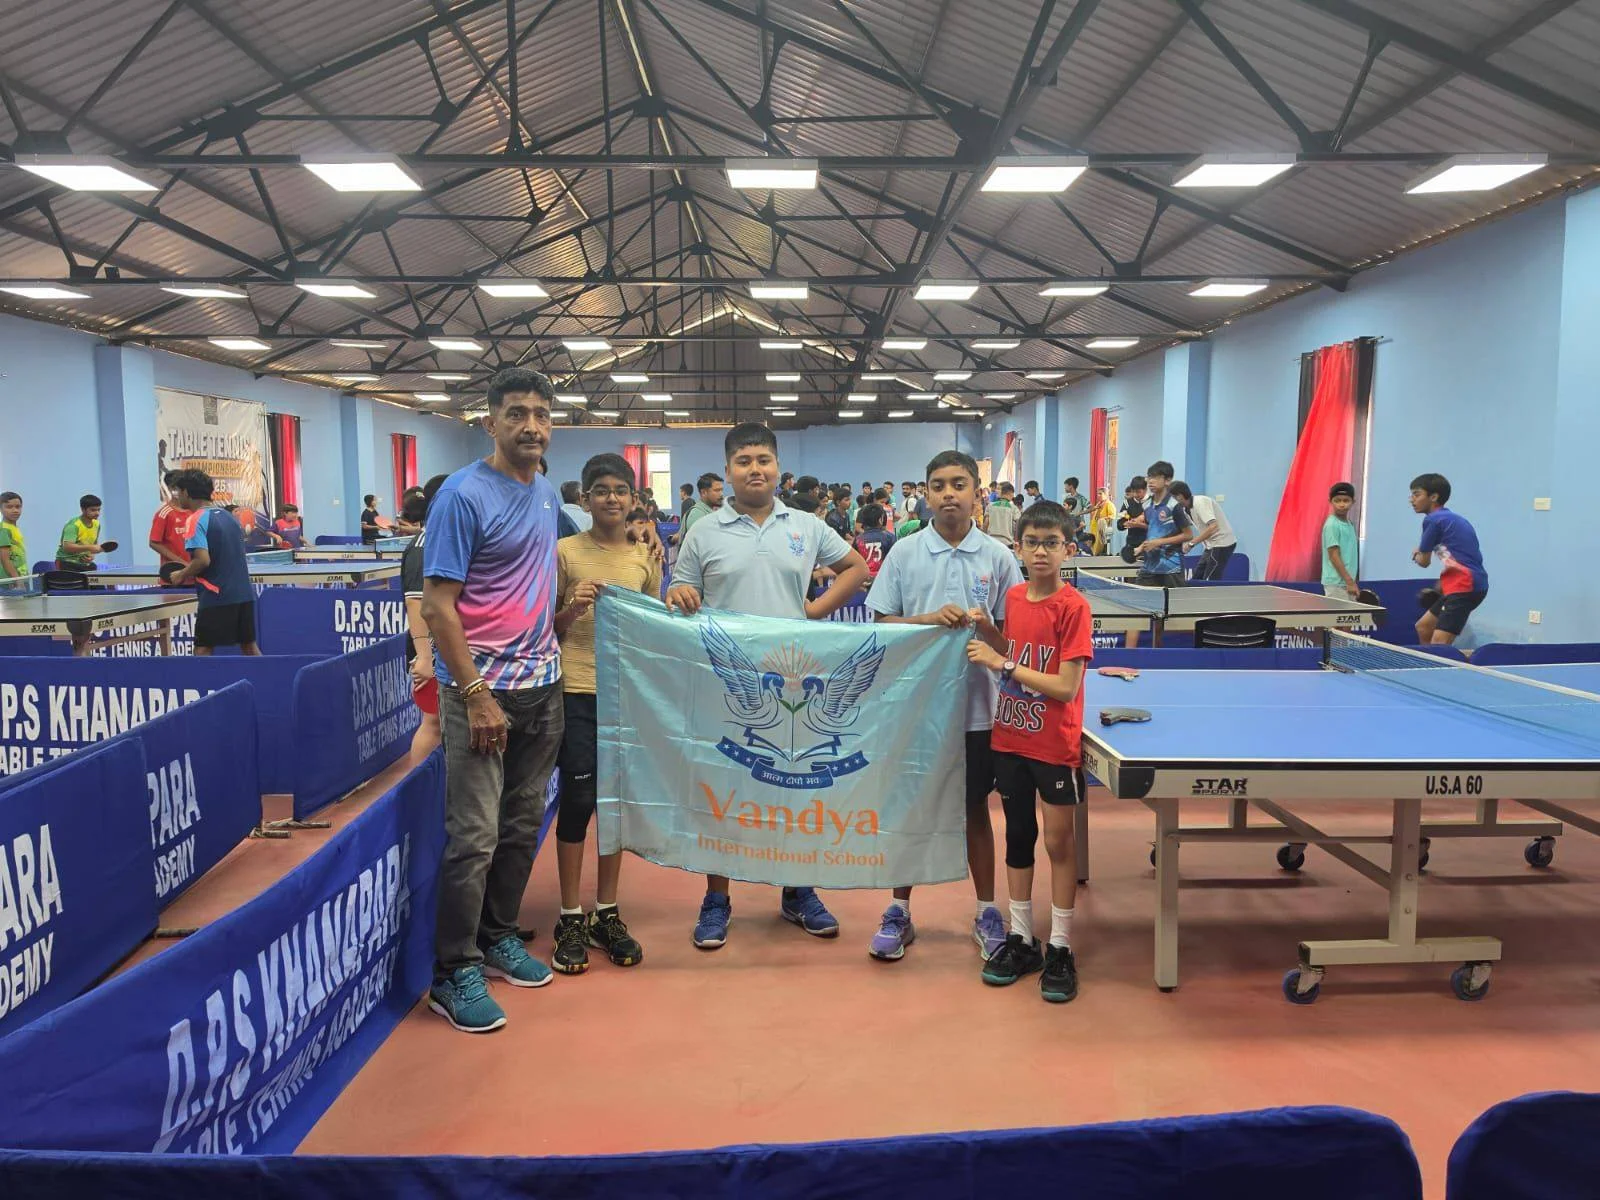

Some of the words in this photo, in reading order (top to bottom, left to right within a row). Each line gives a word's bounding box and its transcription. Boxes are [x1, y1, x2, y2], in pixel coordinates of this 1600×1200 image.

[168, 429, 208, 460] TABLE
[865, 541, 882, 562] 73
[334, 599, 375, 634] D.P.S
[111, 640, 151, 658] TENNIS
[1274, 634, 1314, 649] TENNIS
[1191, 777, 1248, 790] STAR
[1425, 775, 1462, 795] U.S.A
[1466, 775, 1483, 795] 60
[698, 781, 880, 846] Vandya
[697, 831, 818, 865] International
[823, 850, 885, 867] School
[257, 832, 412, 1074] KHANAPARA
